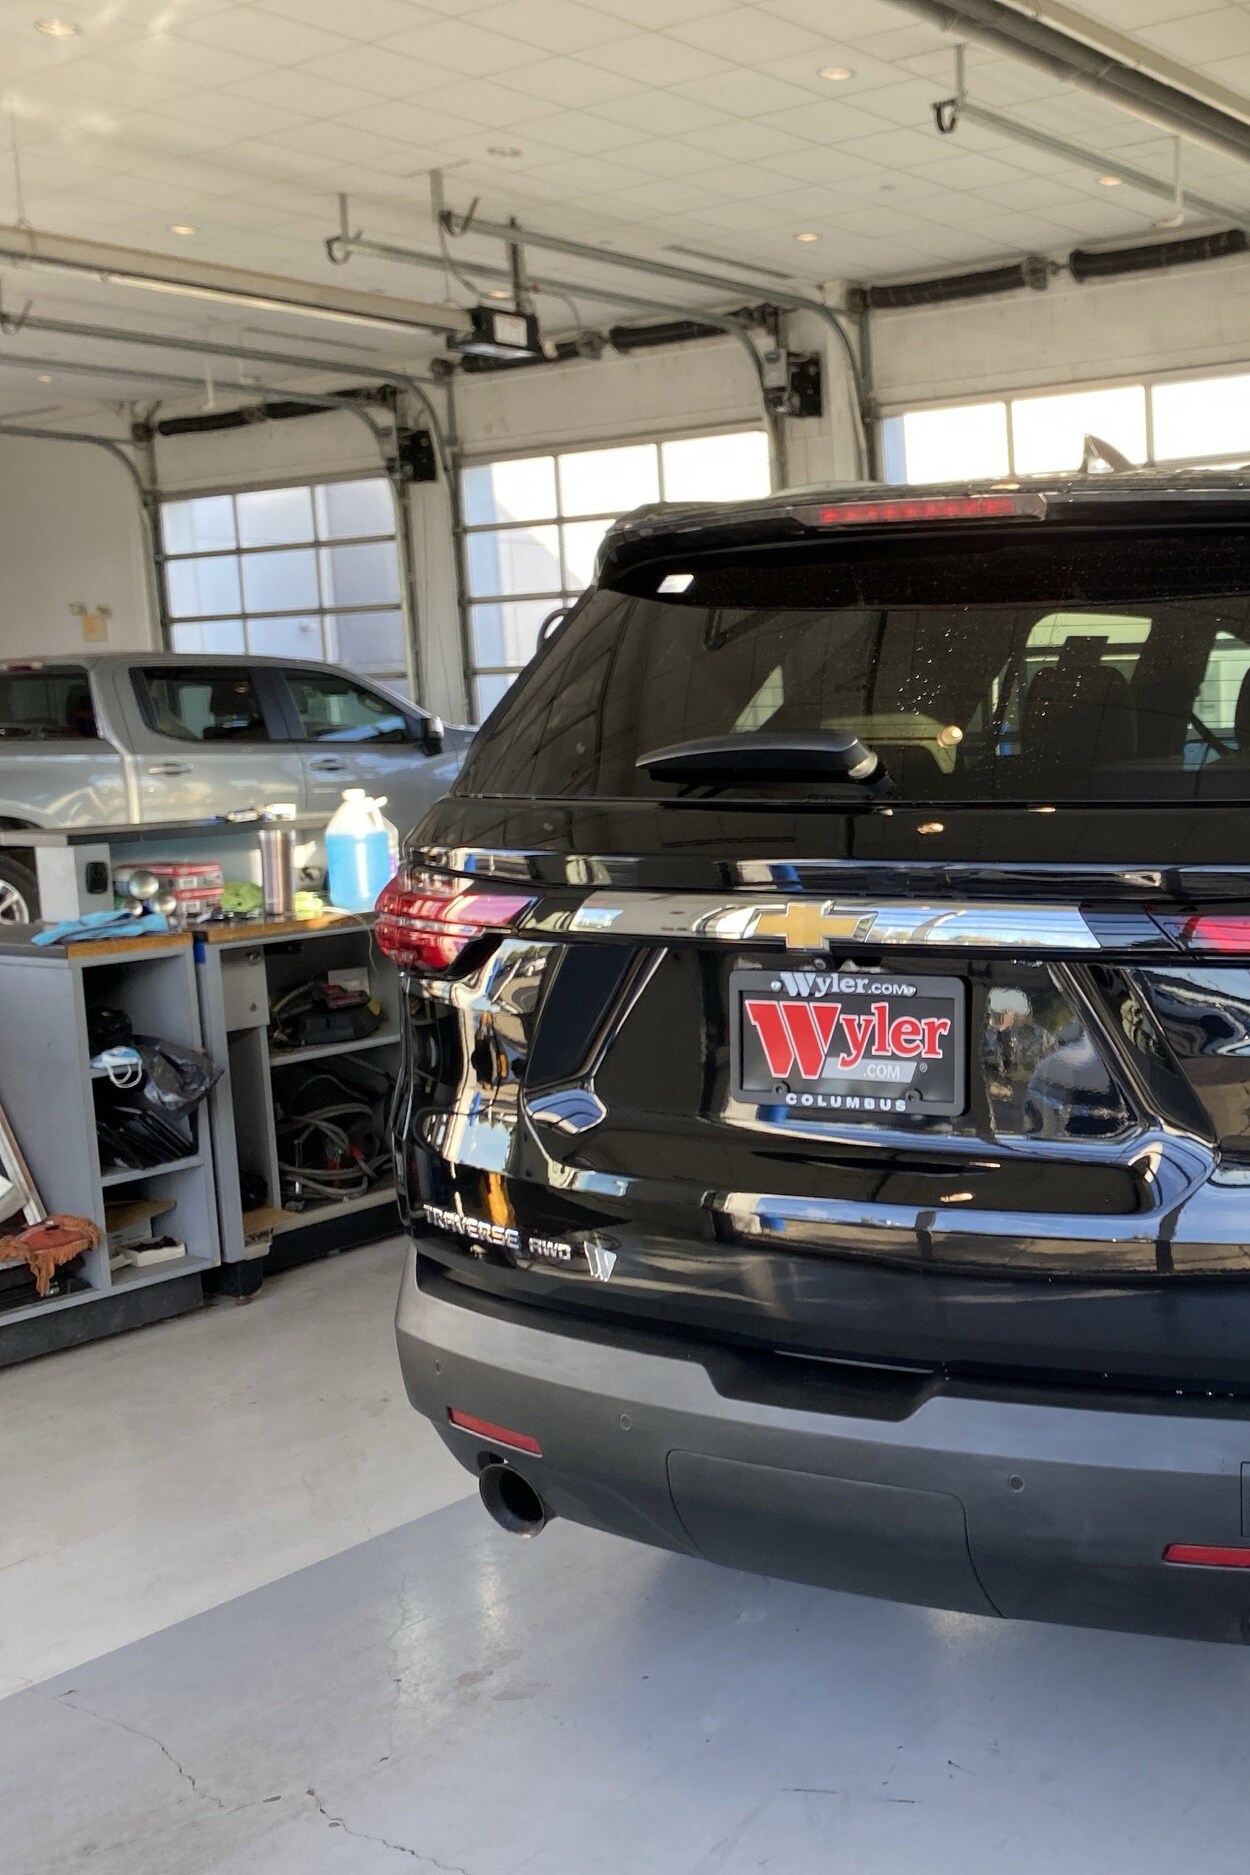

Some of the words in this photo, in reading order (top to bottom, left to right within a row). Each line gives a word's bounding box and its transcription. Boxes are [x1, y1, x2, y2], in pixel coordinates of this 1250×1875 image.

[745, 999, 951, 1080] Wyler
[862, 1063, 901, 1079] .COM
[785, 1093, 907, 1112] COLUMBUS
[423, 1203, 520, 1249] TRAVERSE
